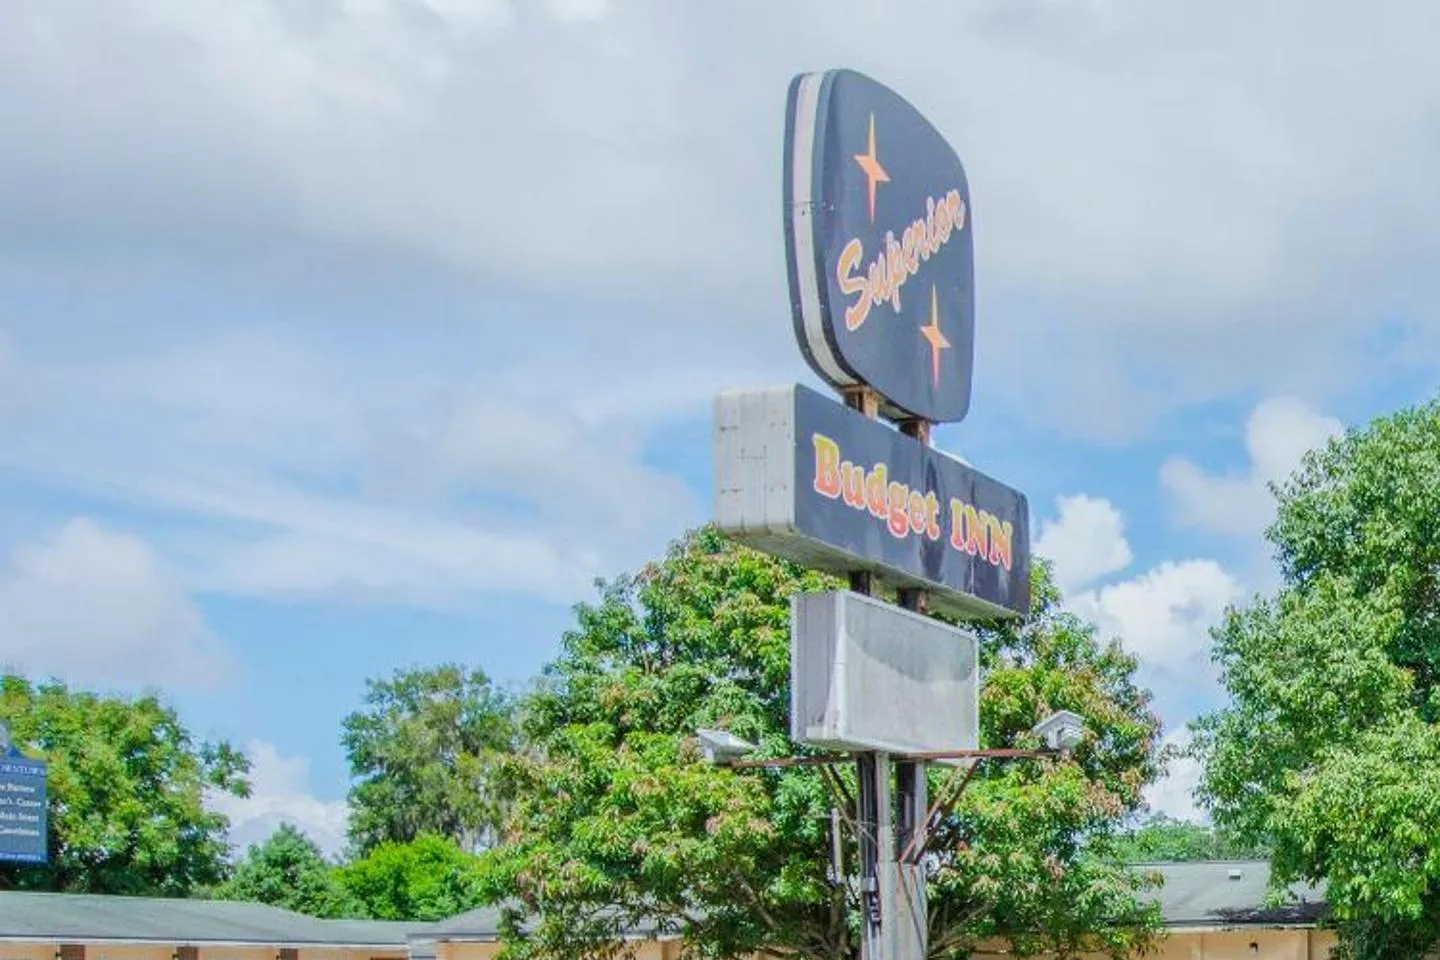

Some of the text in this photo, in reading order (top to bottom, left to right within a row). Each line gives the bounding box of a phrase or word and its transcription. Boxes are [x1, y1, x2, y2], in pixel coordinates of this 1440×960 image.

[837, 189, 965, 331] Superior
[813, 433, 1013, 571] Budget INN
